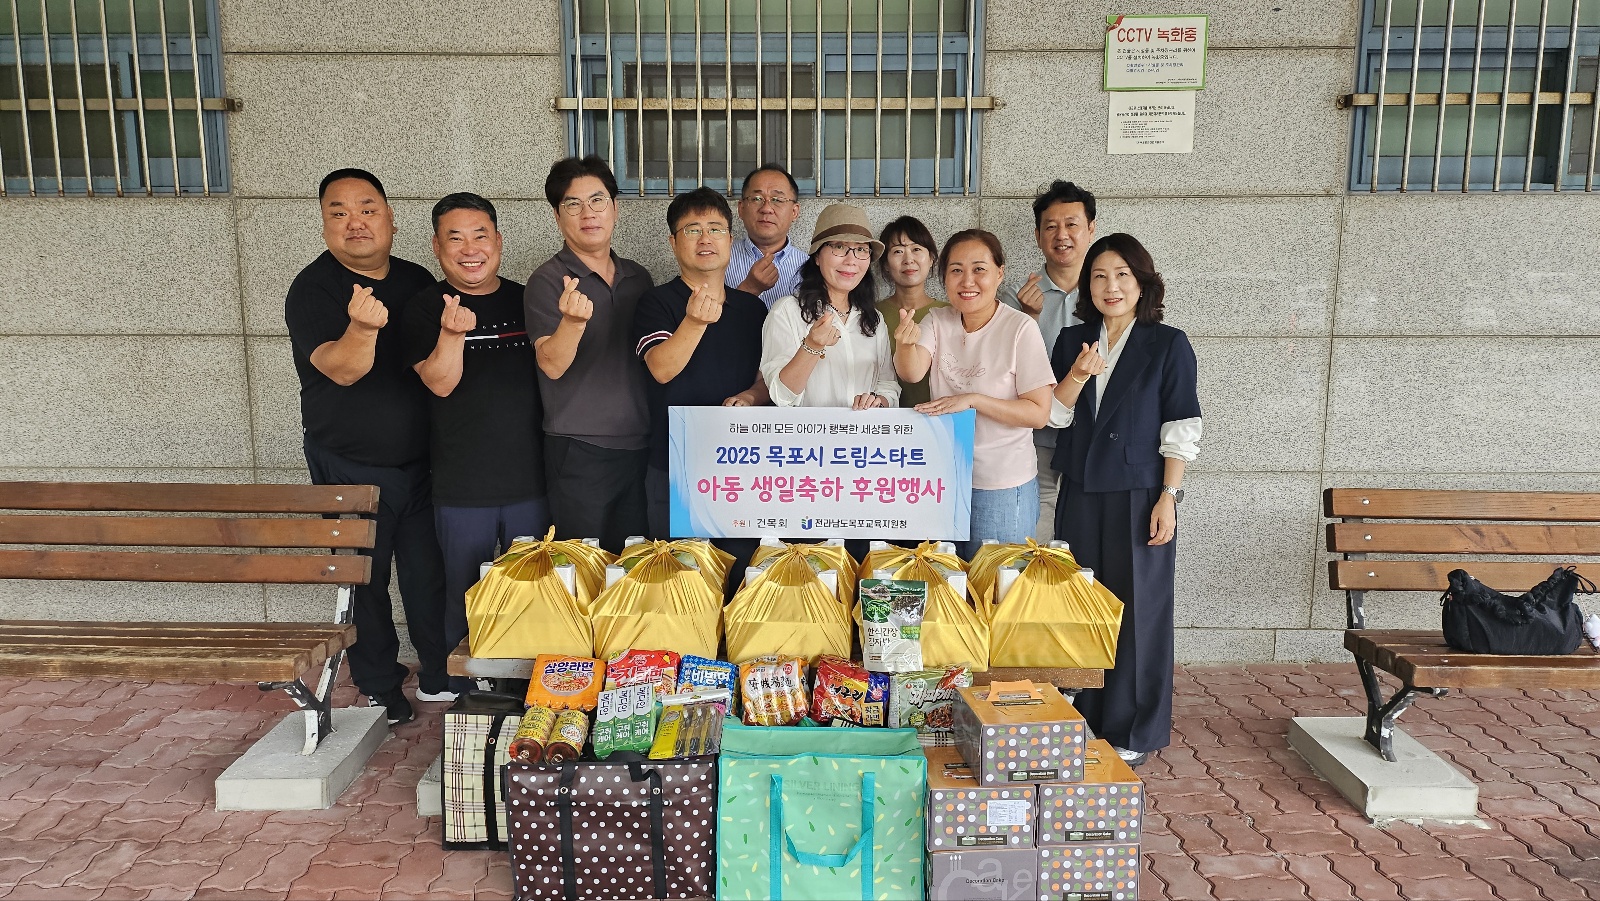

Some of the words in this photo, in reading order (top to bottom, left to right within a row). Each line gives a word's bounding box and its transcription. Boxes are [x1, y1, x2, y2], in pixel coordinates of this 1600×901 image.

[1117, 27, 1153, 43] CCTV
[1157, 27, 1197, 43] 녹화중
[729, 422, 749, 434] 하늘
[752, 423, 772, 434] 아래
[774, 423, 794, 434] 모든
[796, 423, 827, 435] 아이가
[829, 423, 859, 435] 행복한
[861, 424, 891, 435] 세상을
[893, 424, 914, 435] 위한
[716, 446, 760, 465] 2025
[766, 446, 824, 467] 목포시
[830, 446, 927, 468] 드림스타트
[697, 476, 744, 503] 아동
[750, 475, 844, 503] 생일축하
[850, 476, 946, 504] 후원행사
[757, 518, 788, 529] 건목회
[815, 518, 908, 529] 전라남도목포교육지원청
[544, 660, 595, 675] 삼양라면
[828, 683, 864, 701] 너구리
[783, 780, 821, 790] SILVER
[825, 782, 860, 792] LINING
